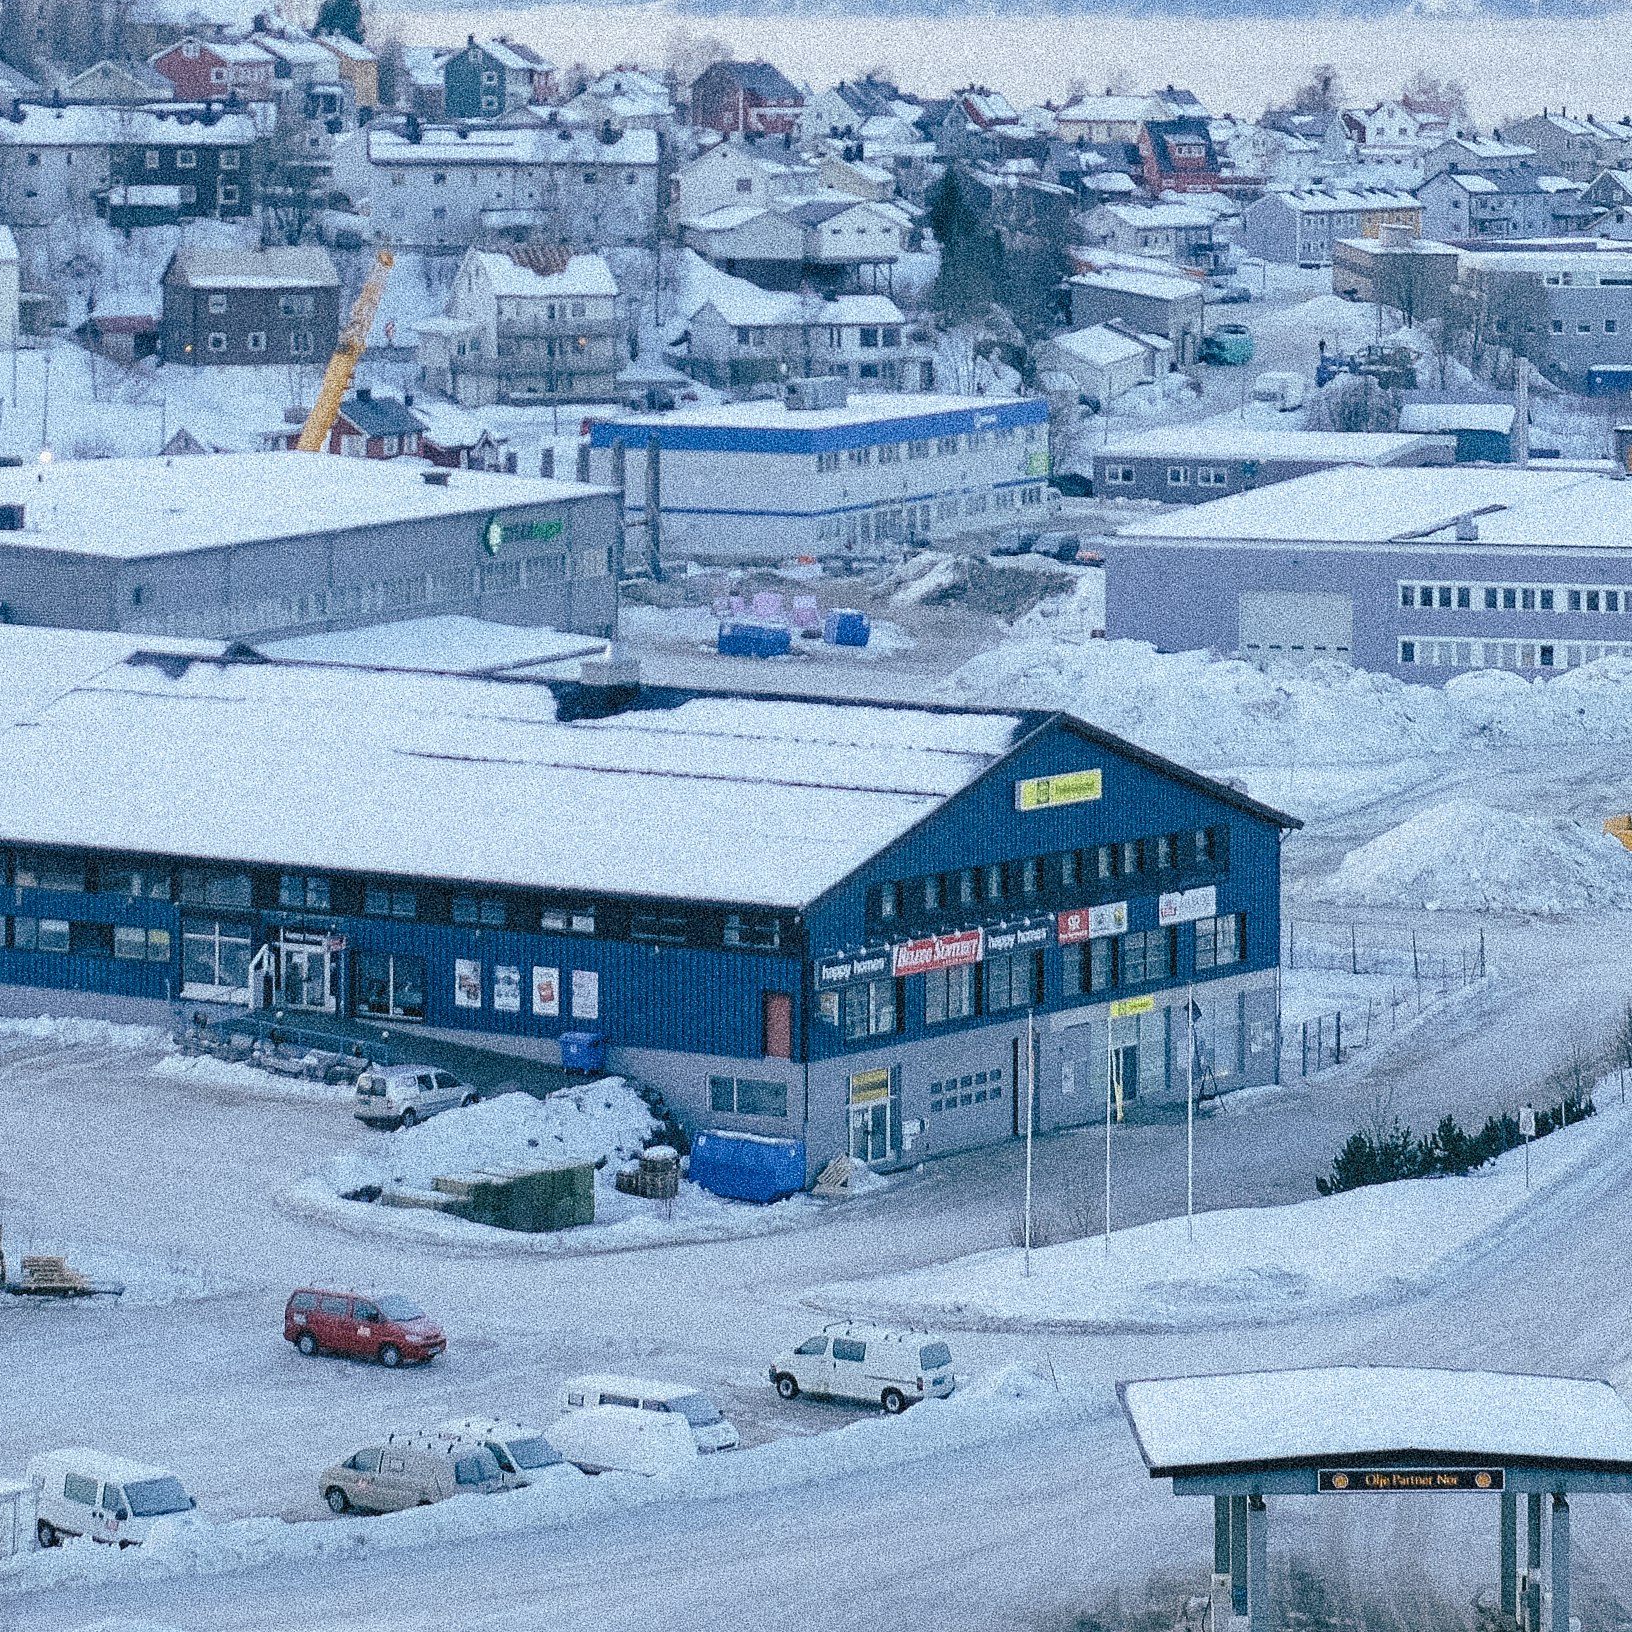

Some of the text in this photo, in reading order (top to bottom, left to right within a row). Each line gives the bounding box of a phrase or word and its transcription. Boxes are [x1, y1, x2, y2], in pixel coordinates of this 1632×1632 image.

[987, 933, 1016, 950] happy
[821, 957, 886, 982] happy homes
[1365, 1473, 1459, 1488] Olje Partner Nor
